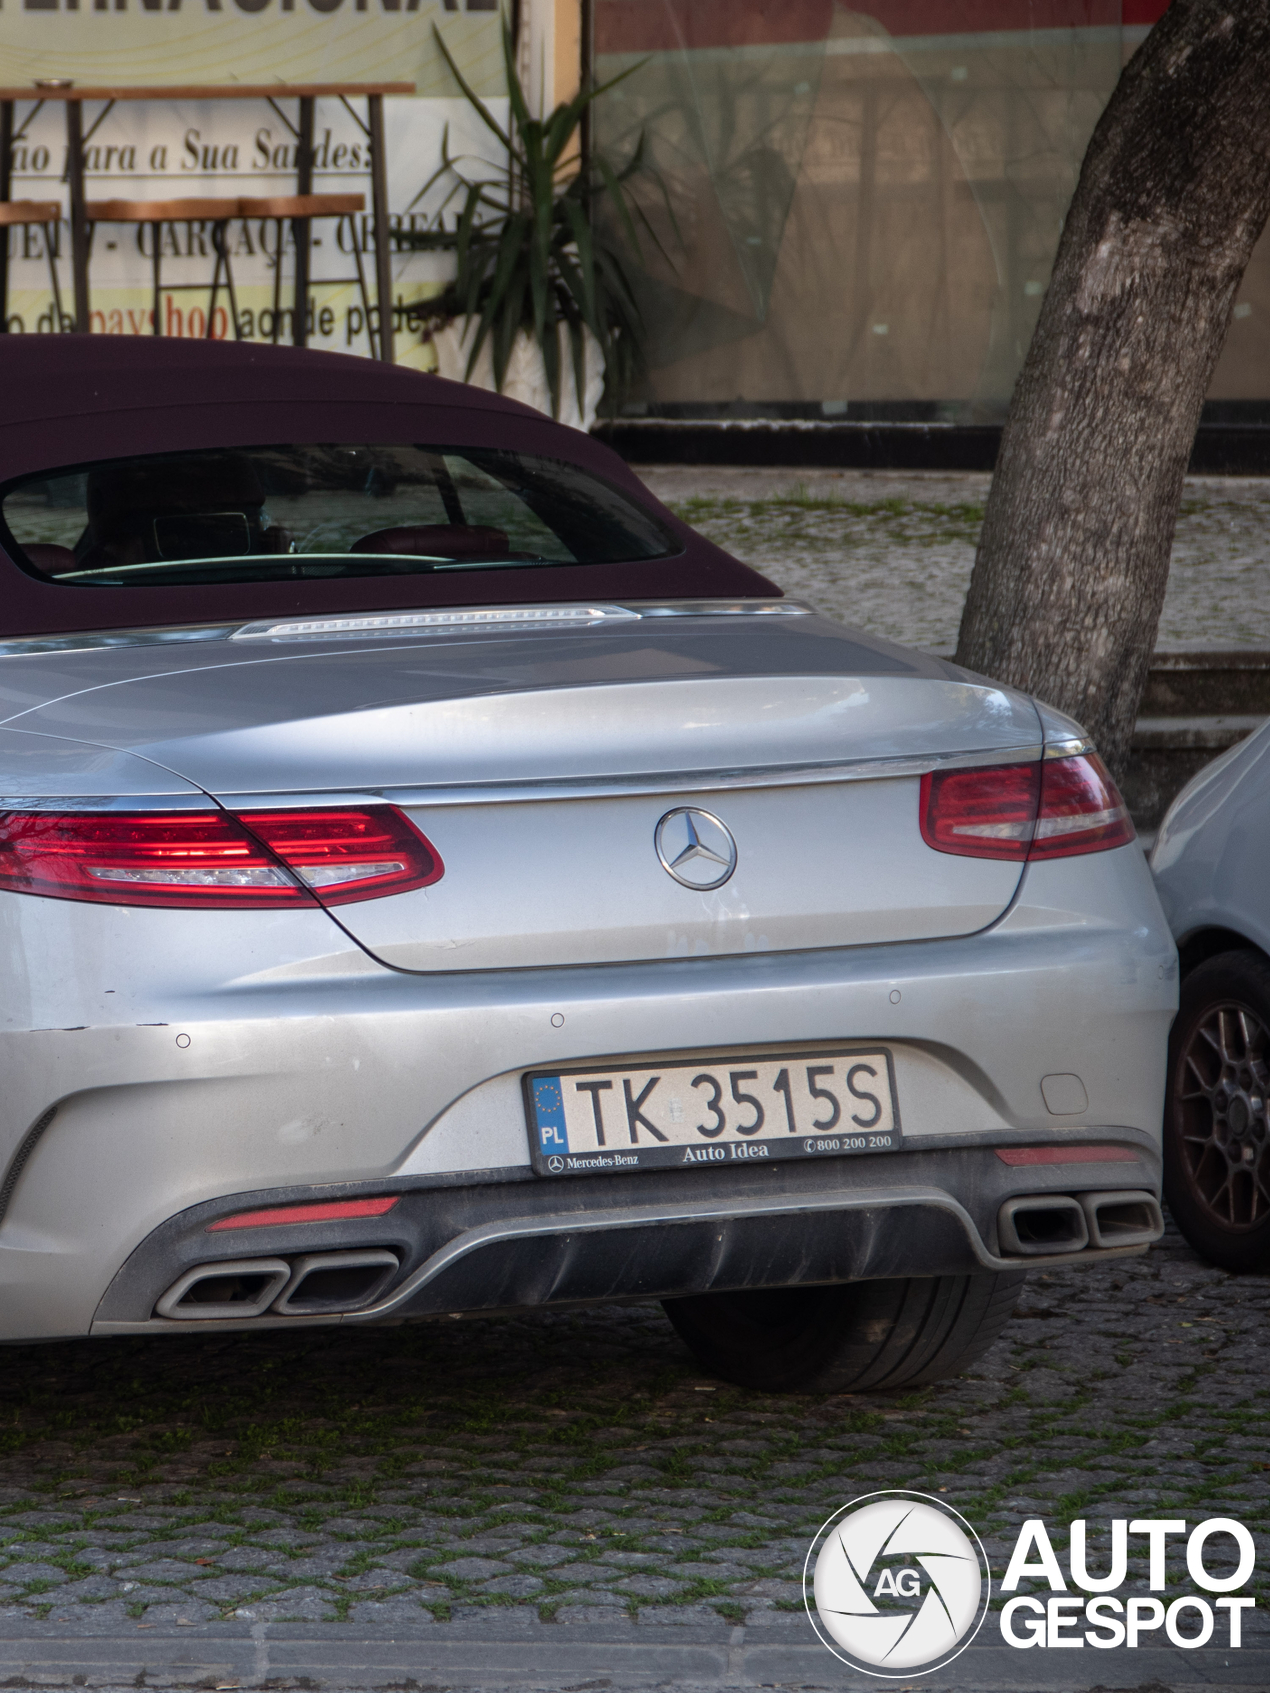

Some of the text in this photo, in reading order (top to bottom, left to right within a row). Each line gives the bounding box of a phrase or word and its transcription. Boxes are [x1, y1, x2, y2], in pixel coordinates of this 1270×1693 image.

[149, 144, 168, 171] a
[182, 128, 239, 171] Sua
[575, 1063, 883, 1147] TK 3515S
[541, 1127, 564, 1145] PL
[816, 1135, 892, 1152] 800 200 200
[566, 1153, 639, 1169] Mercedes-Benz
[682, 1143, 770, 1163] Auto Idea
